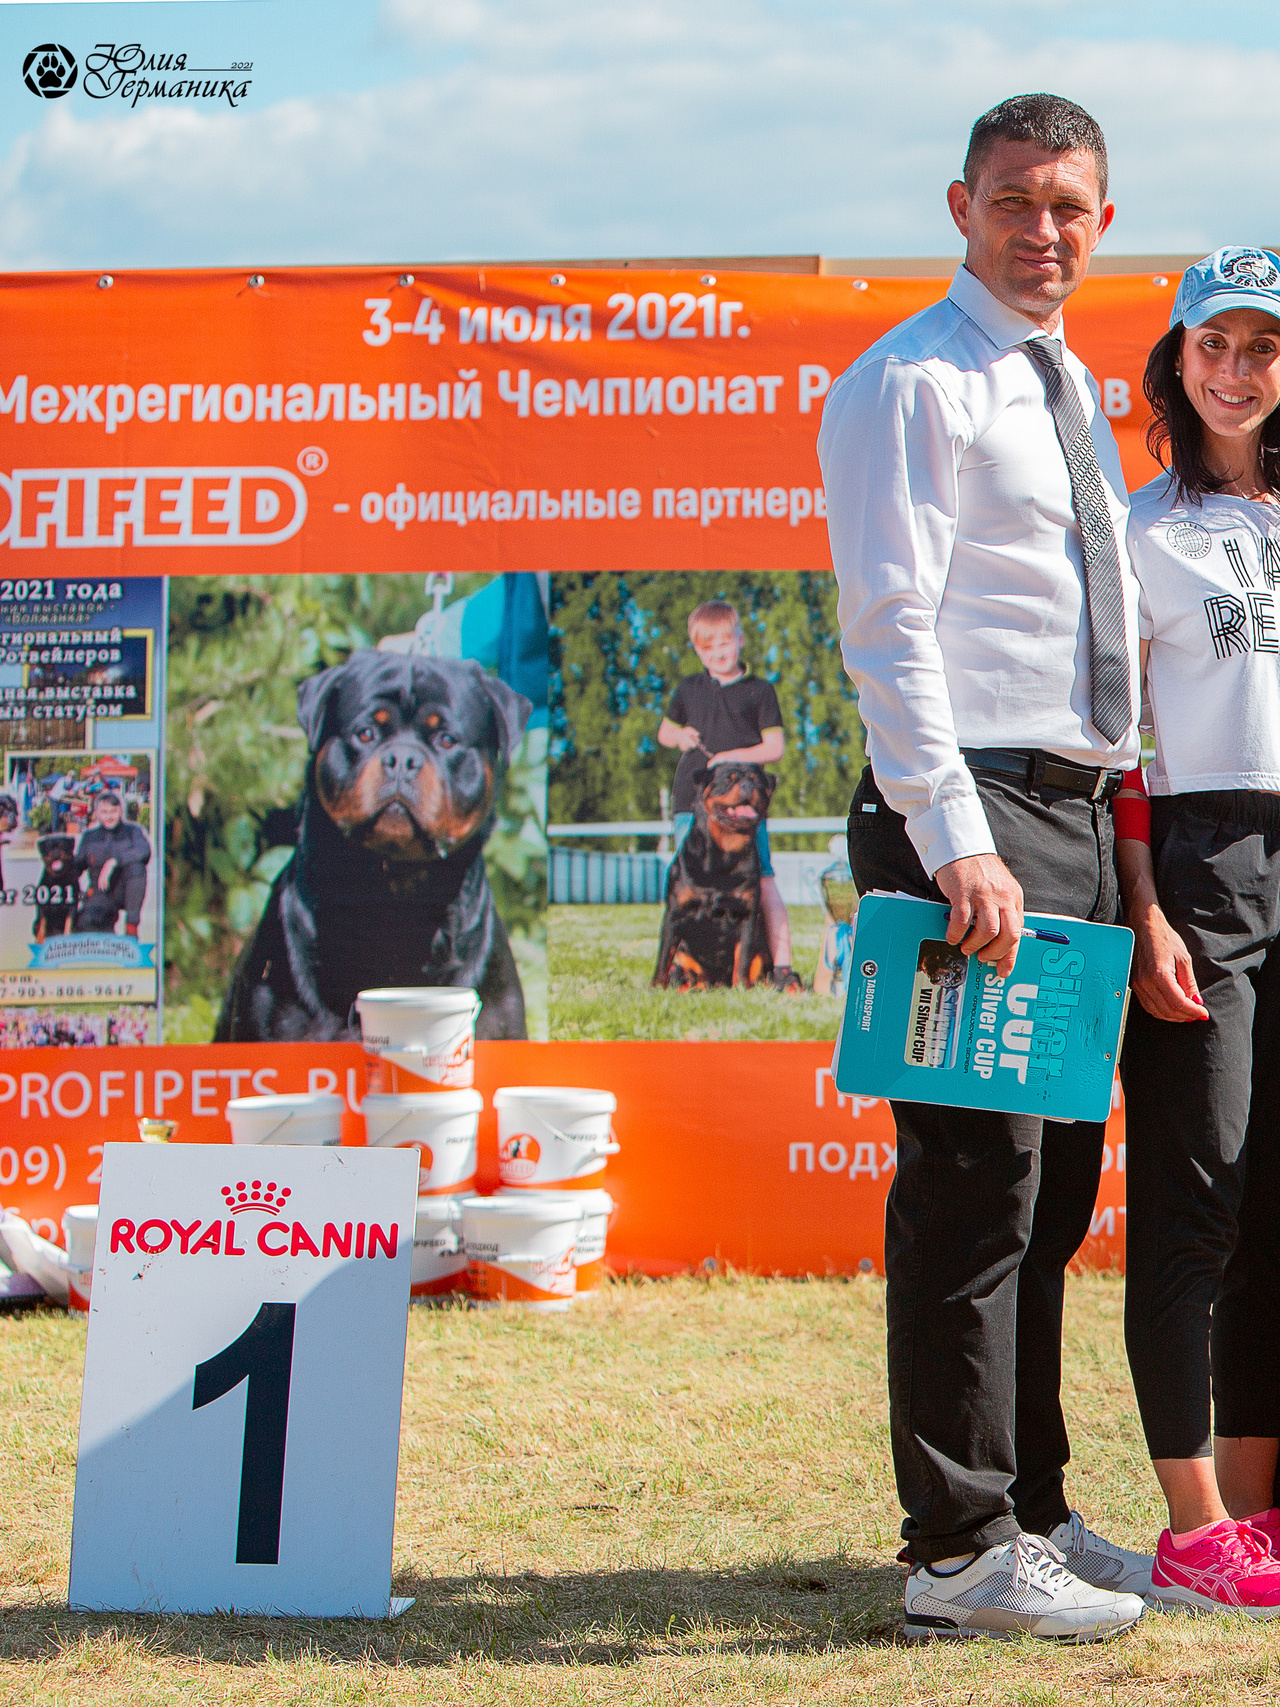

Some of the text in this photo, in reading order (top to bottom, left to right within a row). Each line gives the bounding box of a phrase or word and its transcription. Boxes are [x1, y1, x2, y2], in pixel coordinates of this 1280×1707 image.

[363, 292, 751, 347] 3-4 июля 2021г.
[0, 369, 482, 433] Межрегиональный
[497, 368, 783, 418] Чемпионат
[0, 466, 308, 549] FIFEED
[360, 482, 642, 531] официальные
[1222, 538, 1255, 588] I
[0, 579, 123, 603] 2021 года
[33, 703, 124, 723] статусом
[45, 684, 137, 699] выставка
[22, 885, 74, 905] 2021
[860, 978, 877, 1032] TABOOSPORT
[911, 988, 933, 1063] VII Silver CUP
[977, 973, 1005, 1034] Silver
[972, 1037, 997, 1080] CUP
[110, 1218, 399, 1259] ROYAL CANIN
[192, 1302, 297, 1565] 1
